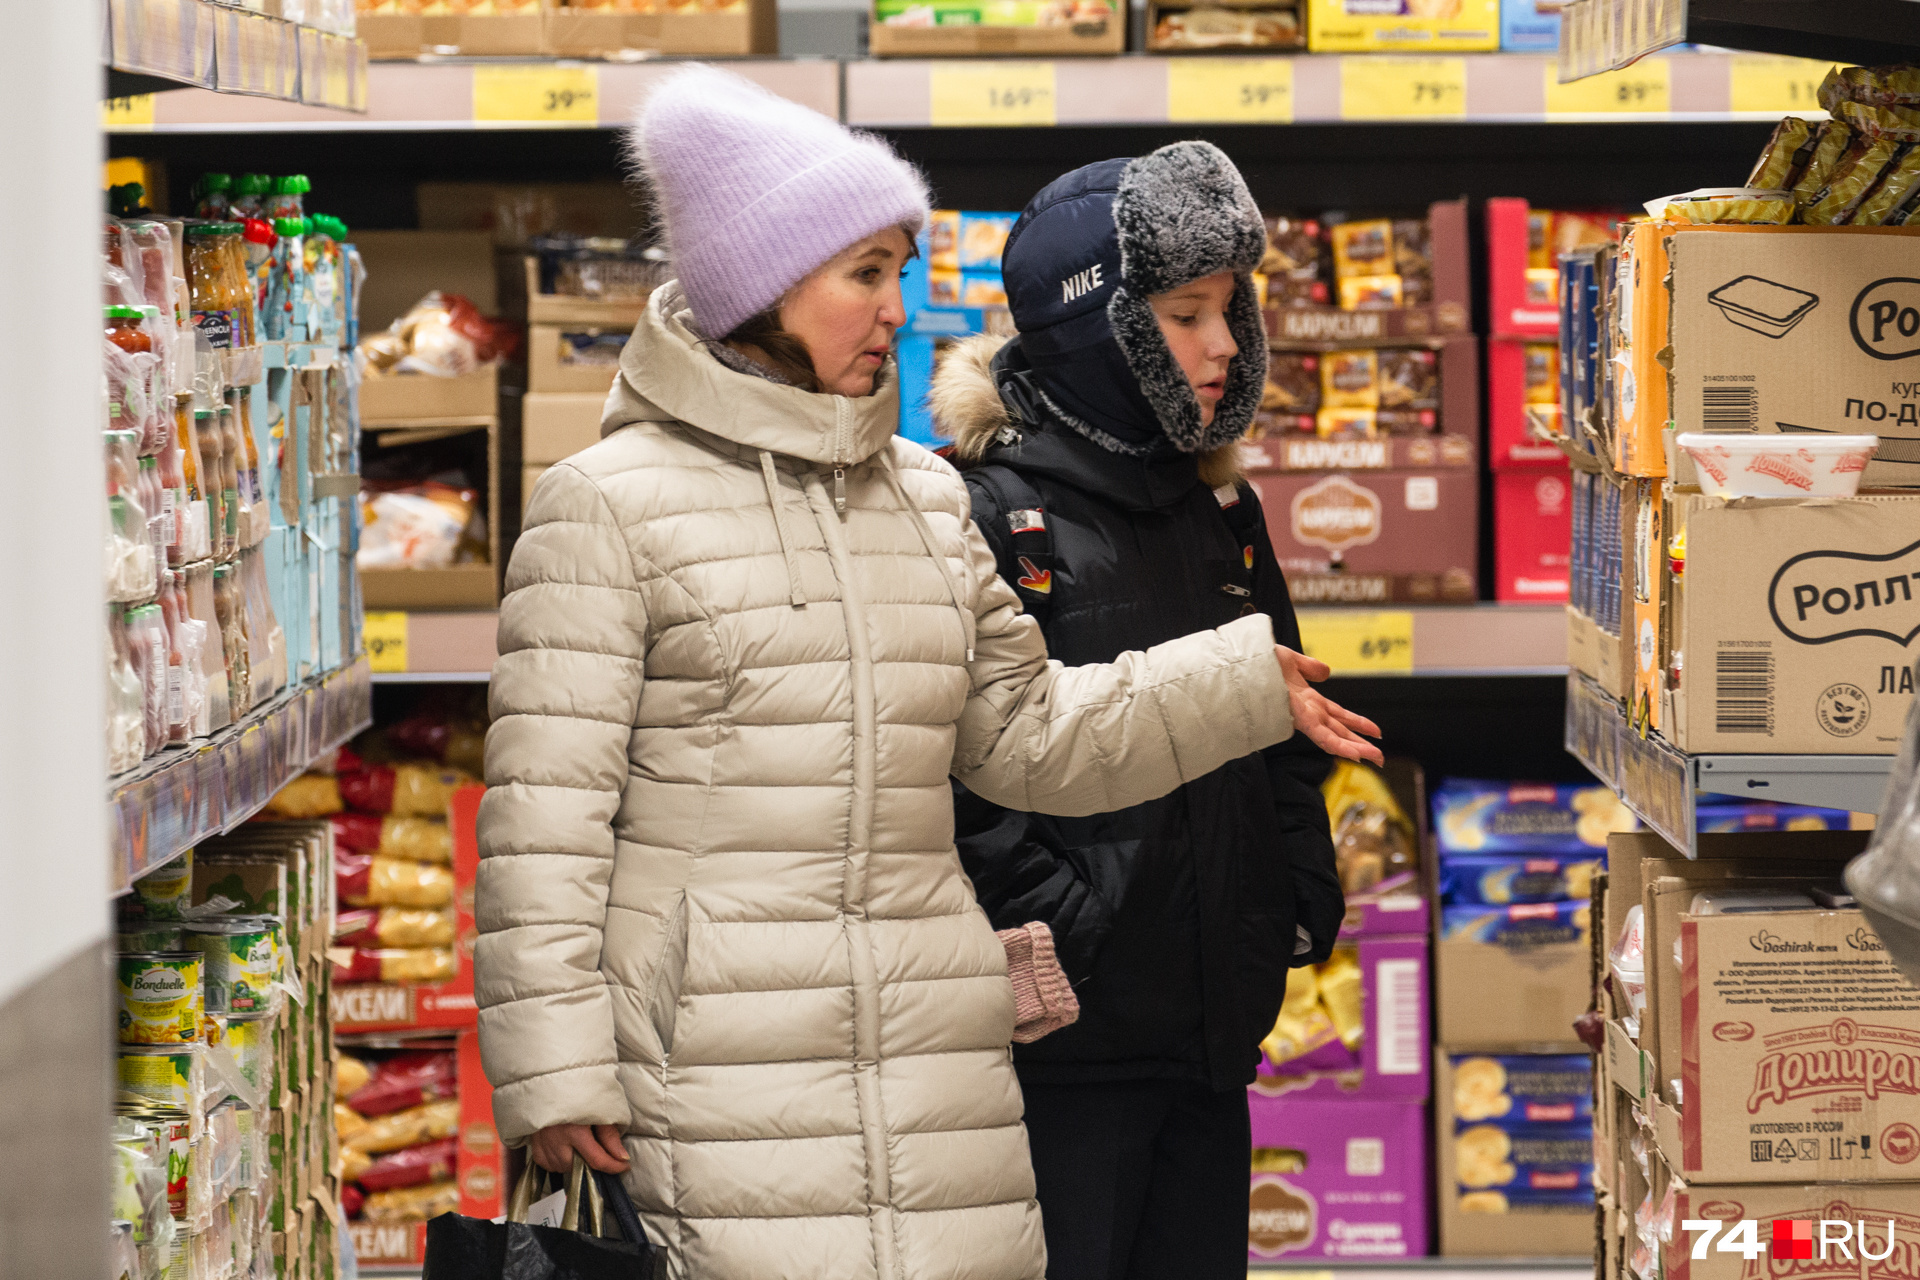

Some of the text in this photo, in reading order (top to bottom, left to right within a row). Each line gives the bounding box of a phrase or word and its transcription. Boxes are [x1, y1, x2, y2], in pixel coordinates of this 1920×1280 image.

[1061, 264, 1104, 303] NIKE
[1845, 398, 1920, 427] ПО-Д
[1763, 940, 1815, 953] Doshirak
[133, 977, 185, 993] Bonduelle
[1749, 1121, 1844, 1135] ИЗГОТОВЛЕНО В РОССИИ
